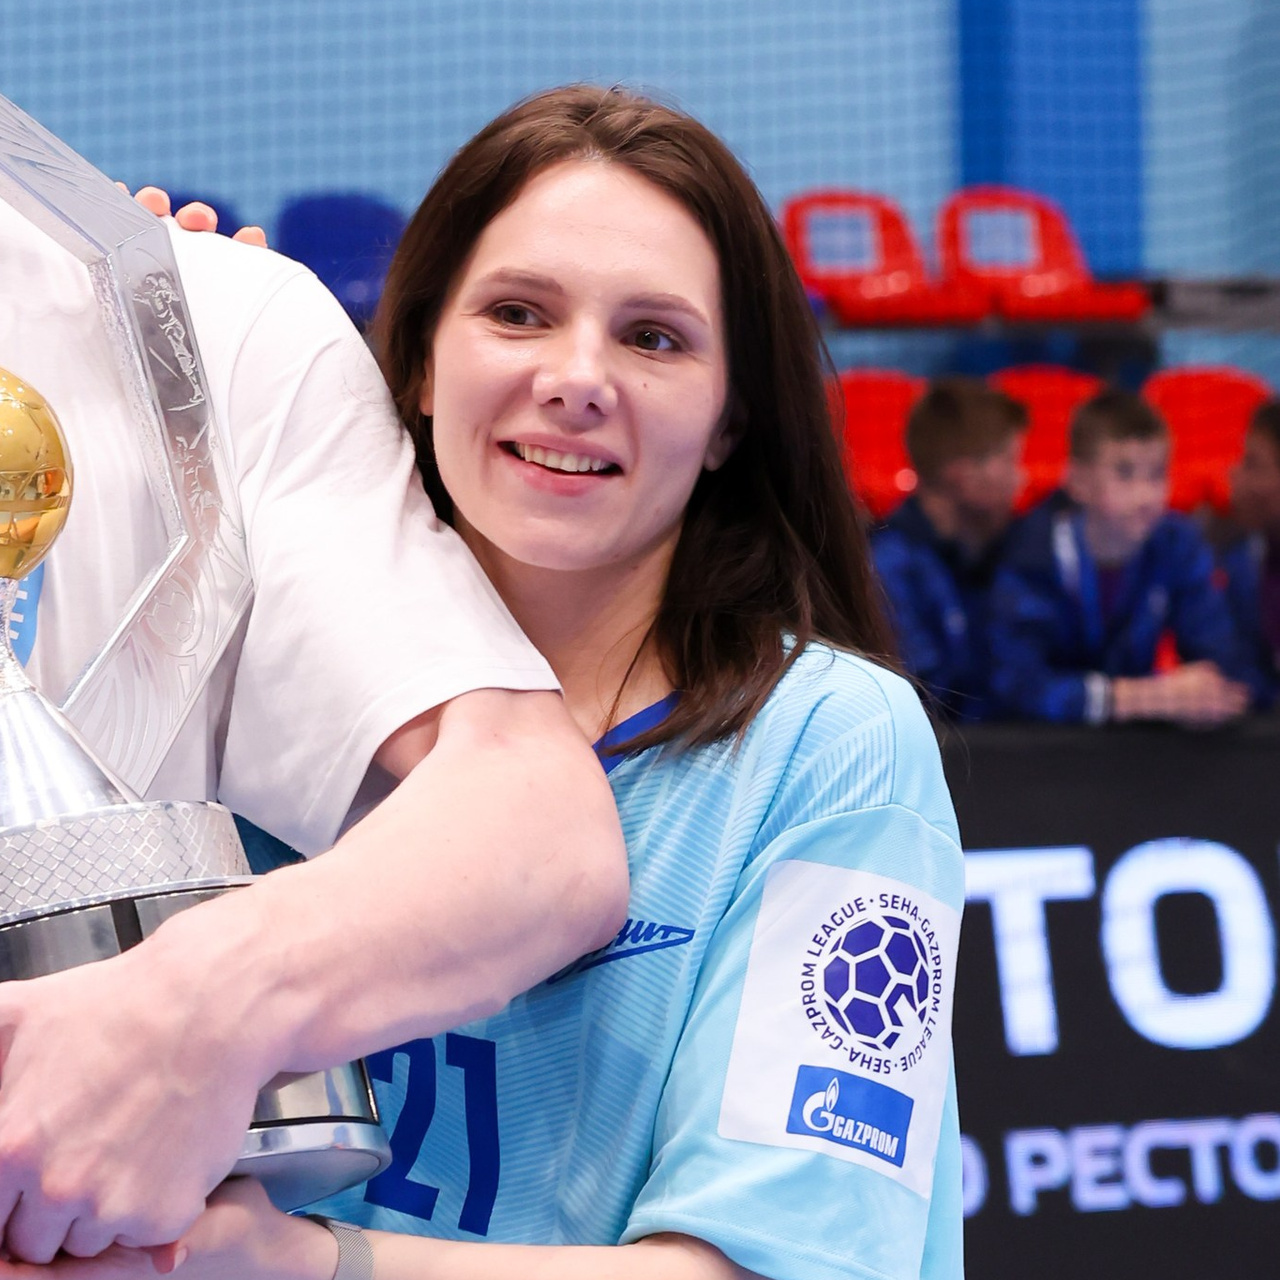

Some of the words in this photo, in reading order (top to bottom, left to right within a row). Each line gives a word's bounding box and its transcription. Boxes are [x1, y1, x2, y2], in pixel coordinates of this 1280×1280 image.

[806, 896, 867, 958] LEAGUE
[879, 893, 943, 1013] SEHA-GAZPROM
[800, 962, 892, 1074] SEHA-GAZPROM
[900, 1017, 937, 1072] LEAGUE
[363, 1032, 501, 1236] 21
[832, 1115, 899, 1158] GAZPROM
